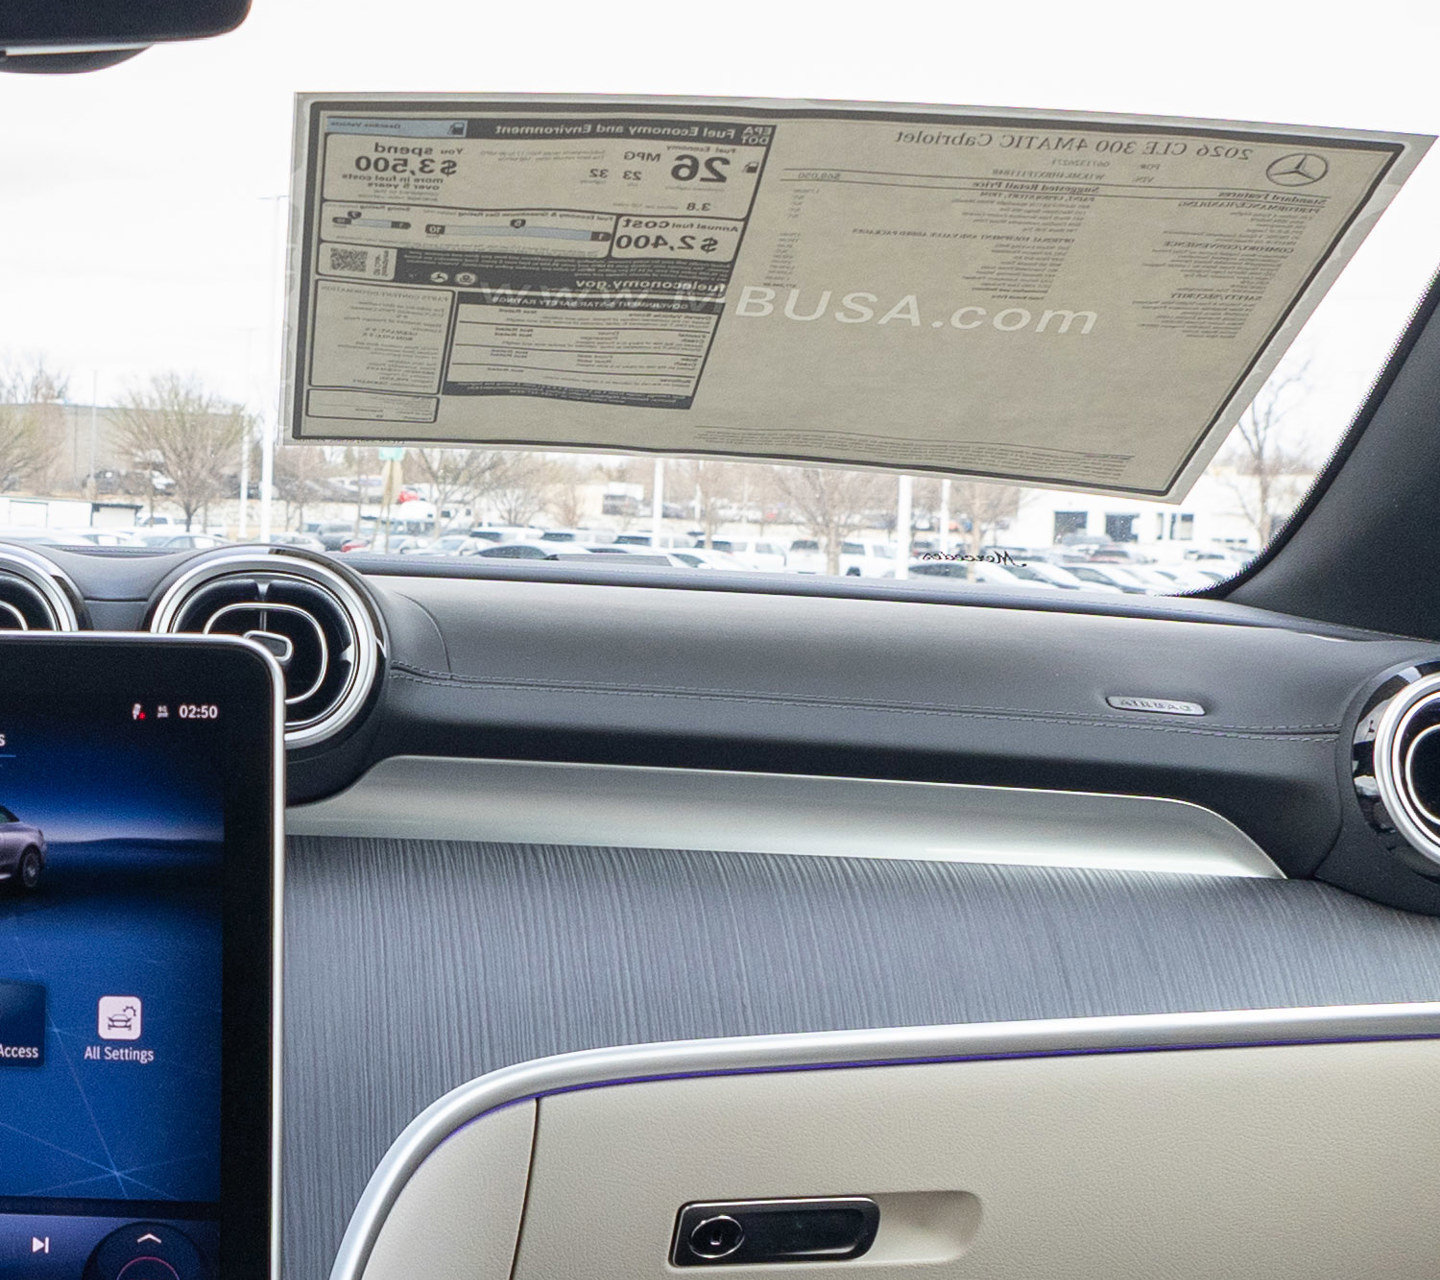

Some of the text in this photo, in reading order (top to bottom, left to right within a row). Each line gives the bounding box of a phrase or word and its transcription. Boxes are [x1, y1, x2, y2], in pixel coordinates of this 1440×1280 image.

[178, 704, 219, 719] 02:50
[84, 1046, 155, 1065] All Settings
